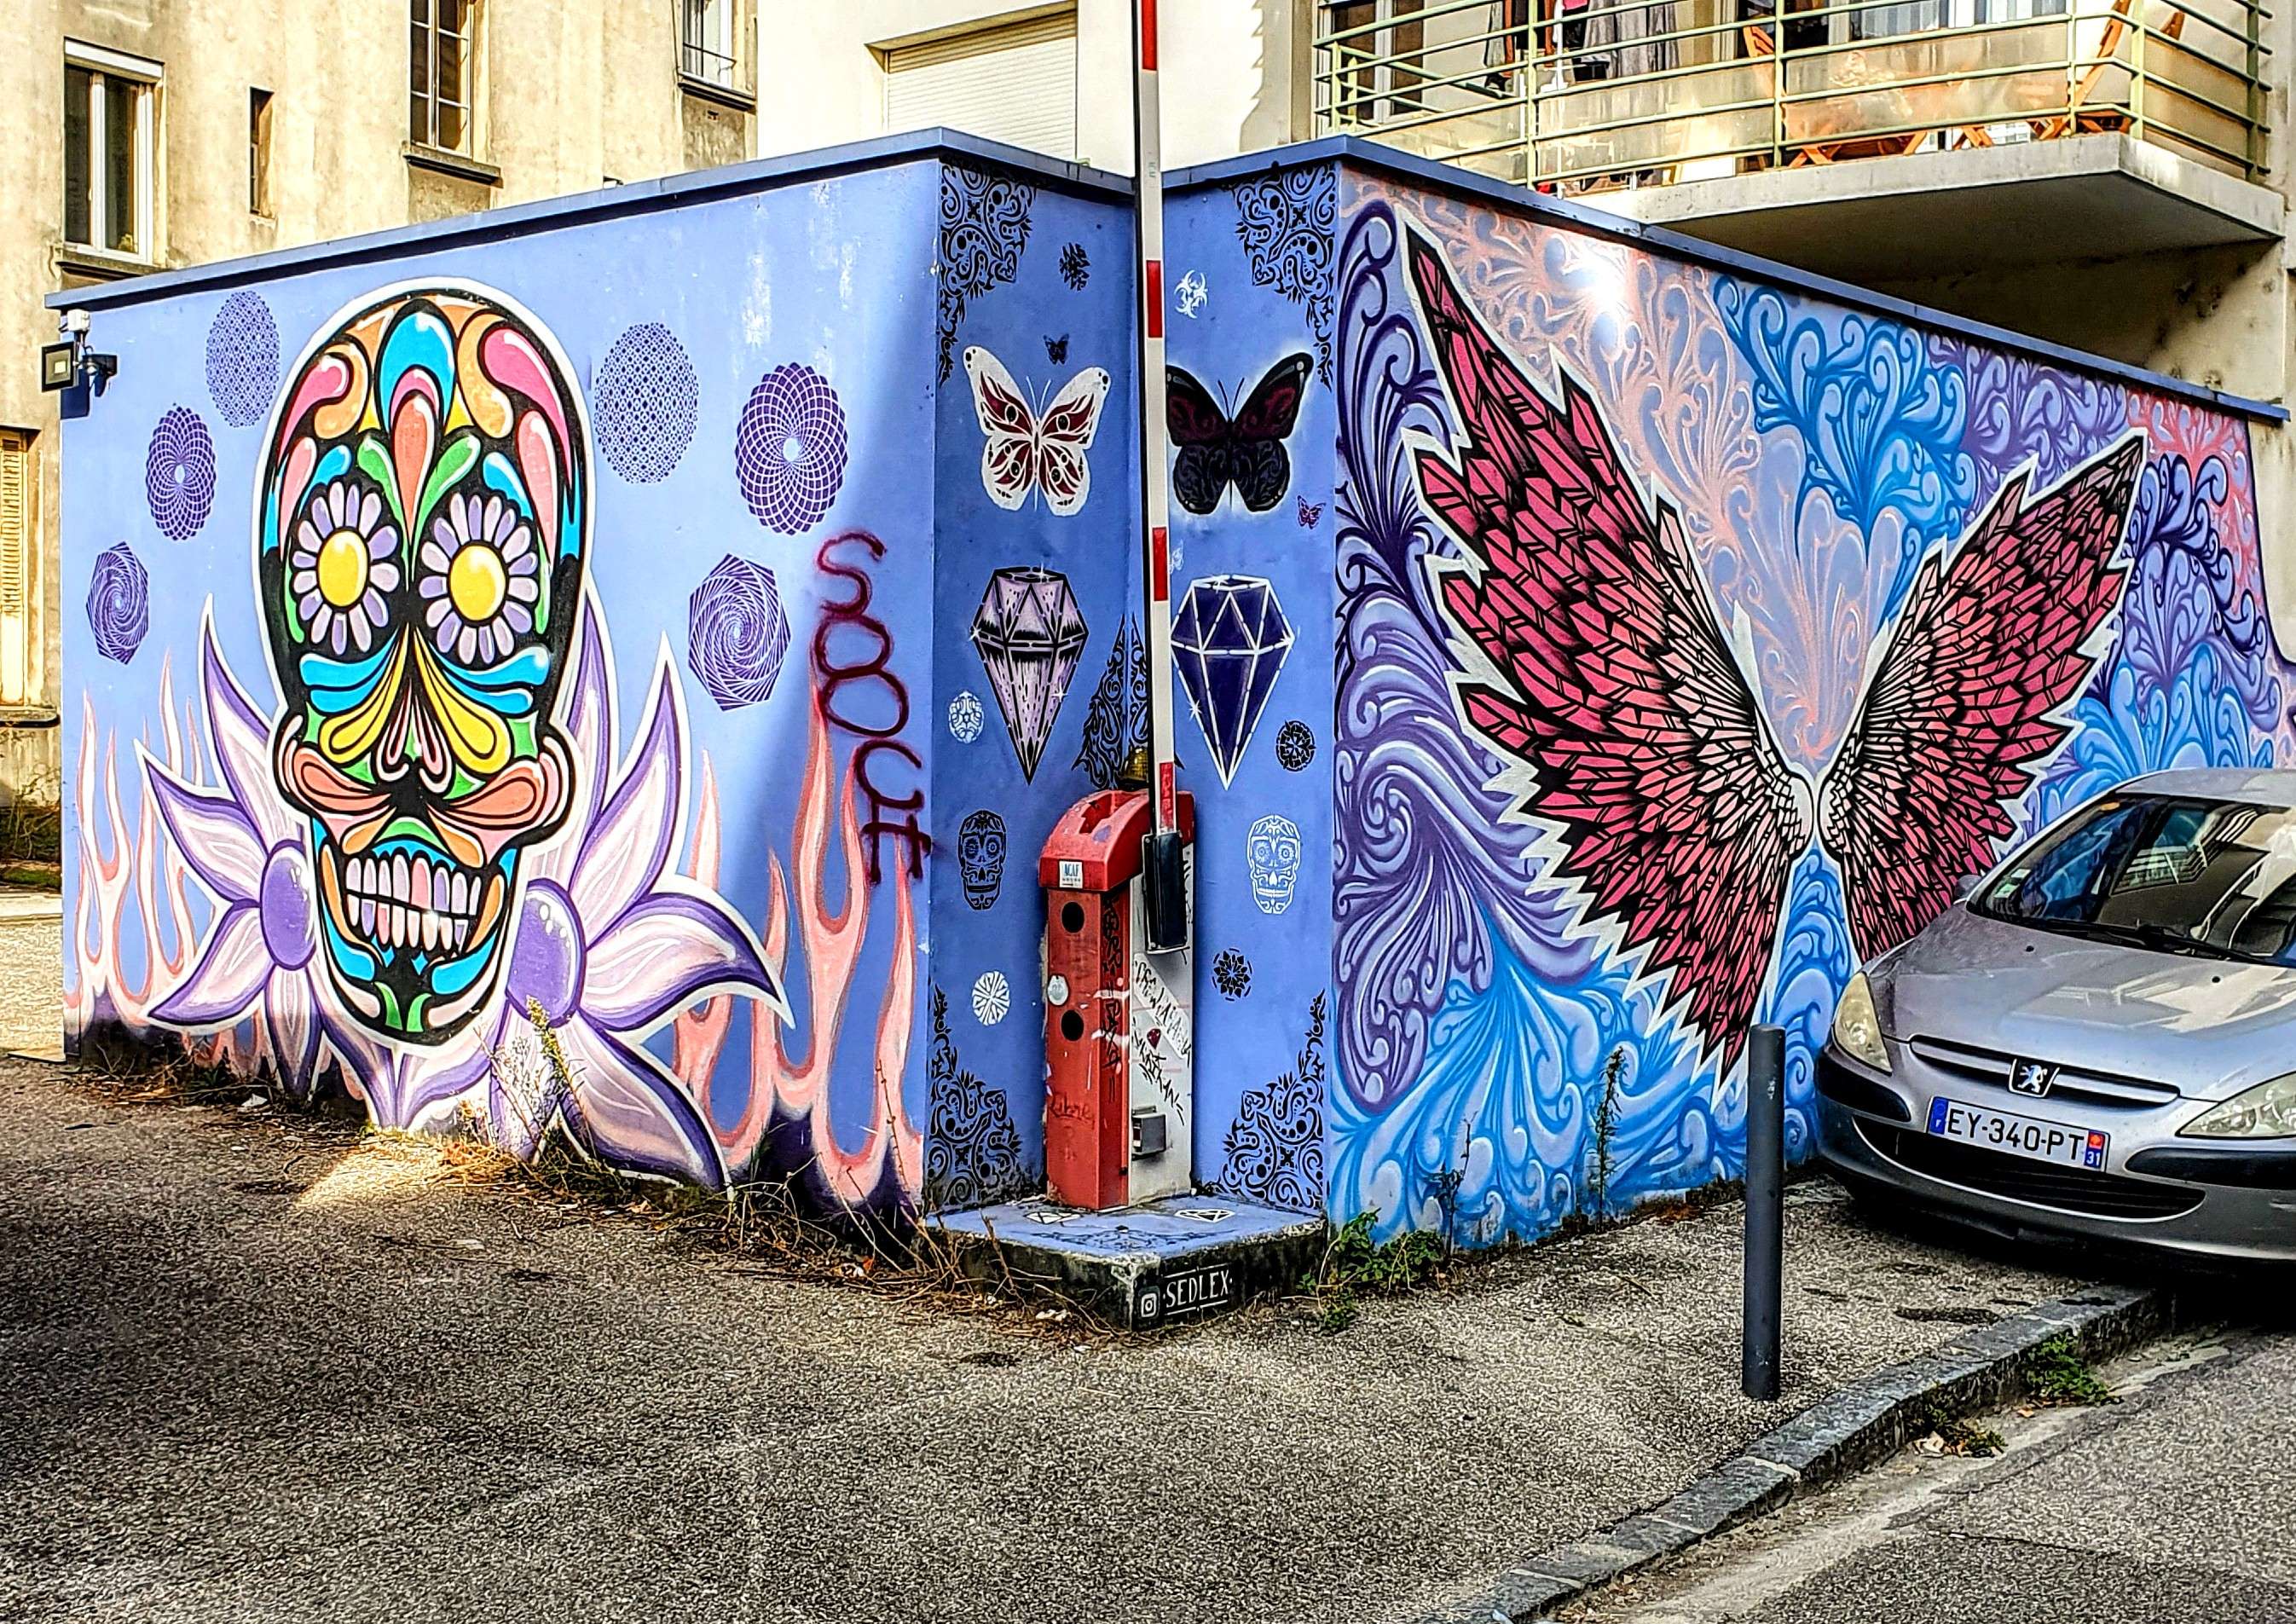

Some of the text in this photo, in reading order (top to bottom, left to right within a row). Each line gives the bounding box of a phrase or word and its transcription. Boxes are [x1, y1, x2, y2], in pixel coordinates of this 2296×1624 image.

[1935, 1118, 1942, 1129] F
[1947, 1107, 2085, 1160] EY-340-PT
[2086, 1150, 2102, 1166] 31
[1165, 1268, 1229, 1309] SEDLEX
